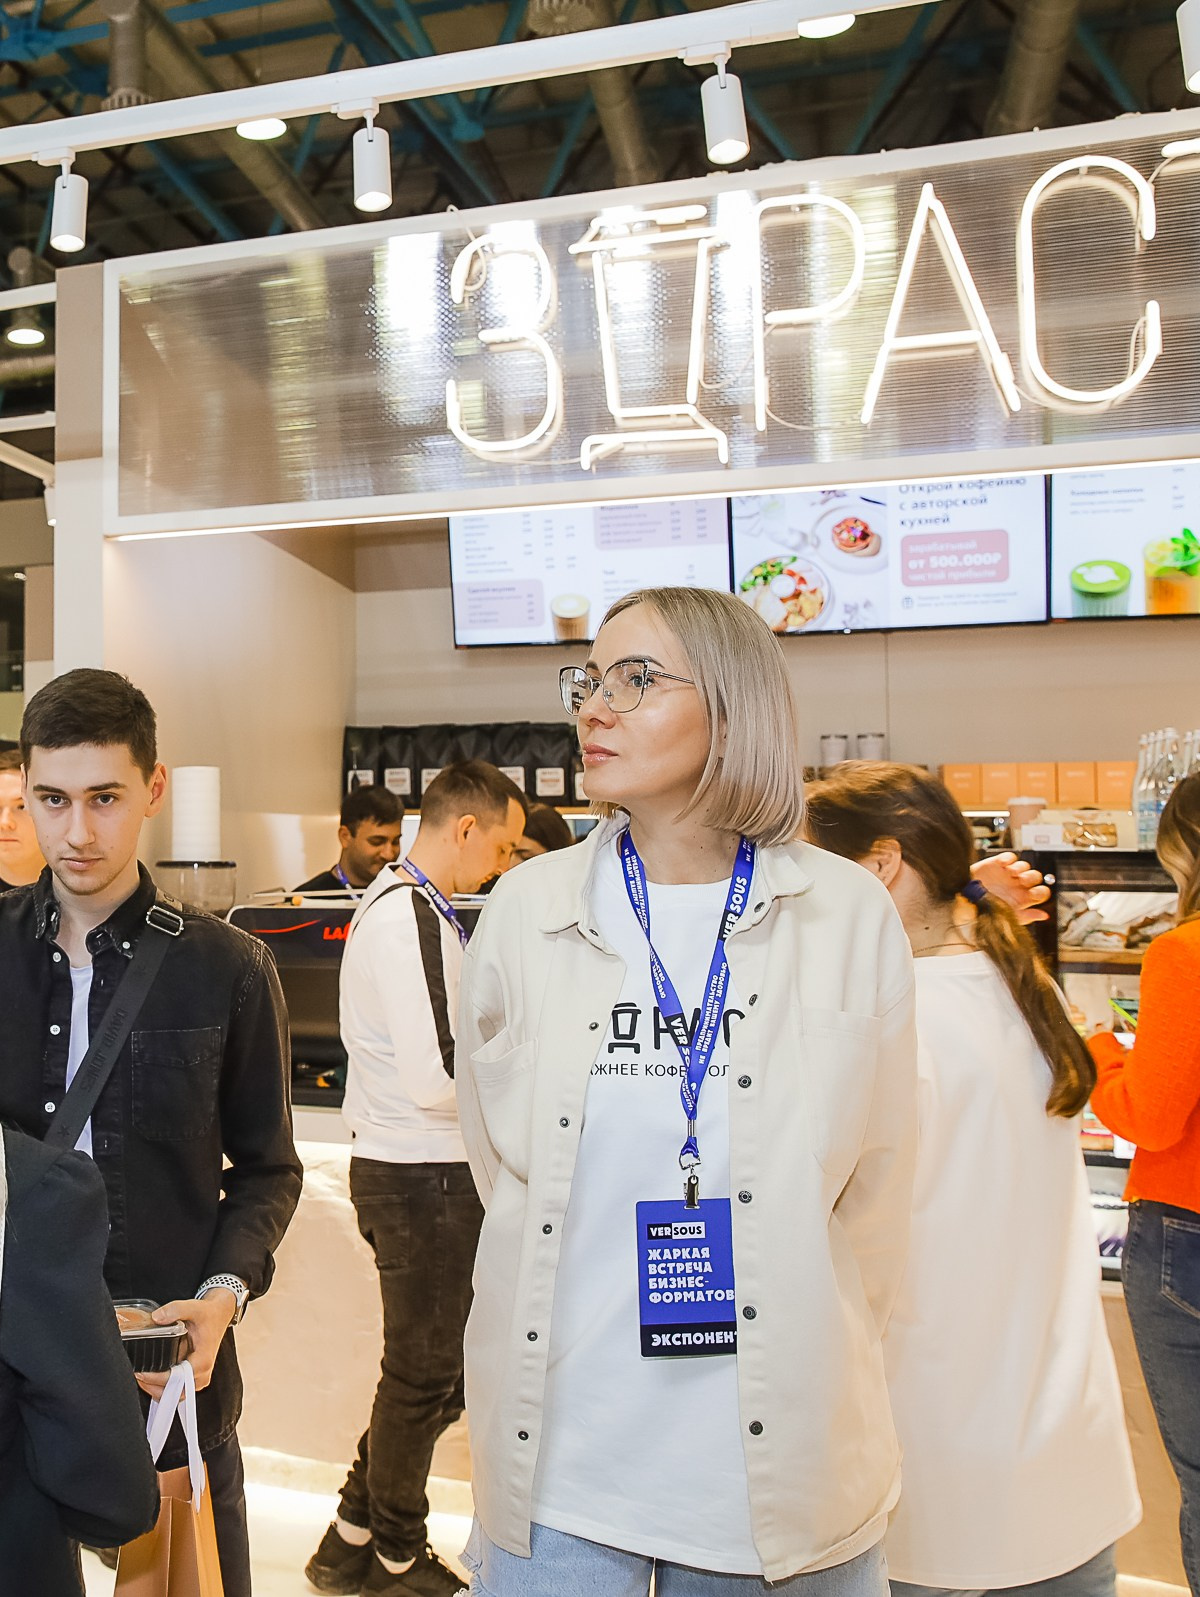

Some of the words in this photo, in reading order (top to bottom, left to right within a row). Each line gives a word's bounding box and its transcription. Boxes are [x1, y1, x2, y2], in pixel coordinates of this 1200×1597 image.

[446, 155, 1200, 471] ЗДРАС
[695, 974, 719, 1051] ПРЕДПРИНИМАТЕЛЬСТВО
[702, 1029, 714, 1053] ВРЕДИТ
[710, 1000, 720, 1028] ВАШЕМУ
[647, 1247, 710, 1261] ЖАРКАЯ
[648, 1261, 713, 1275] ВСТРЕЧА
[648, 1276, 709, 1289] БИЗНЕС-
[649, 1290, 736, 1303] ФОРМАТОВ
